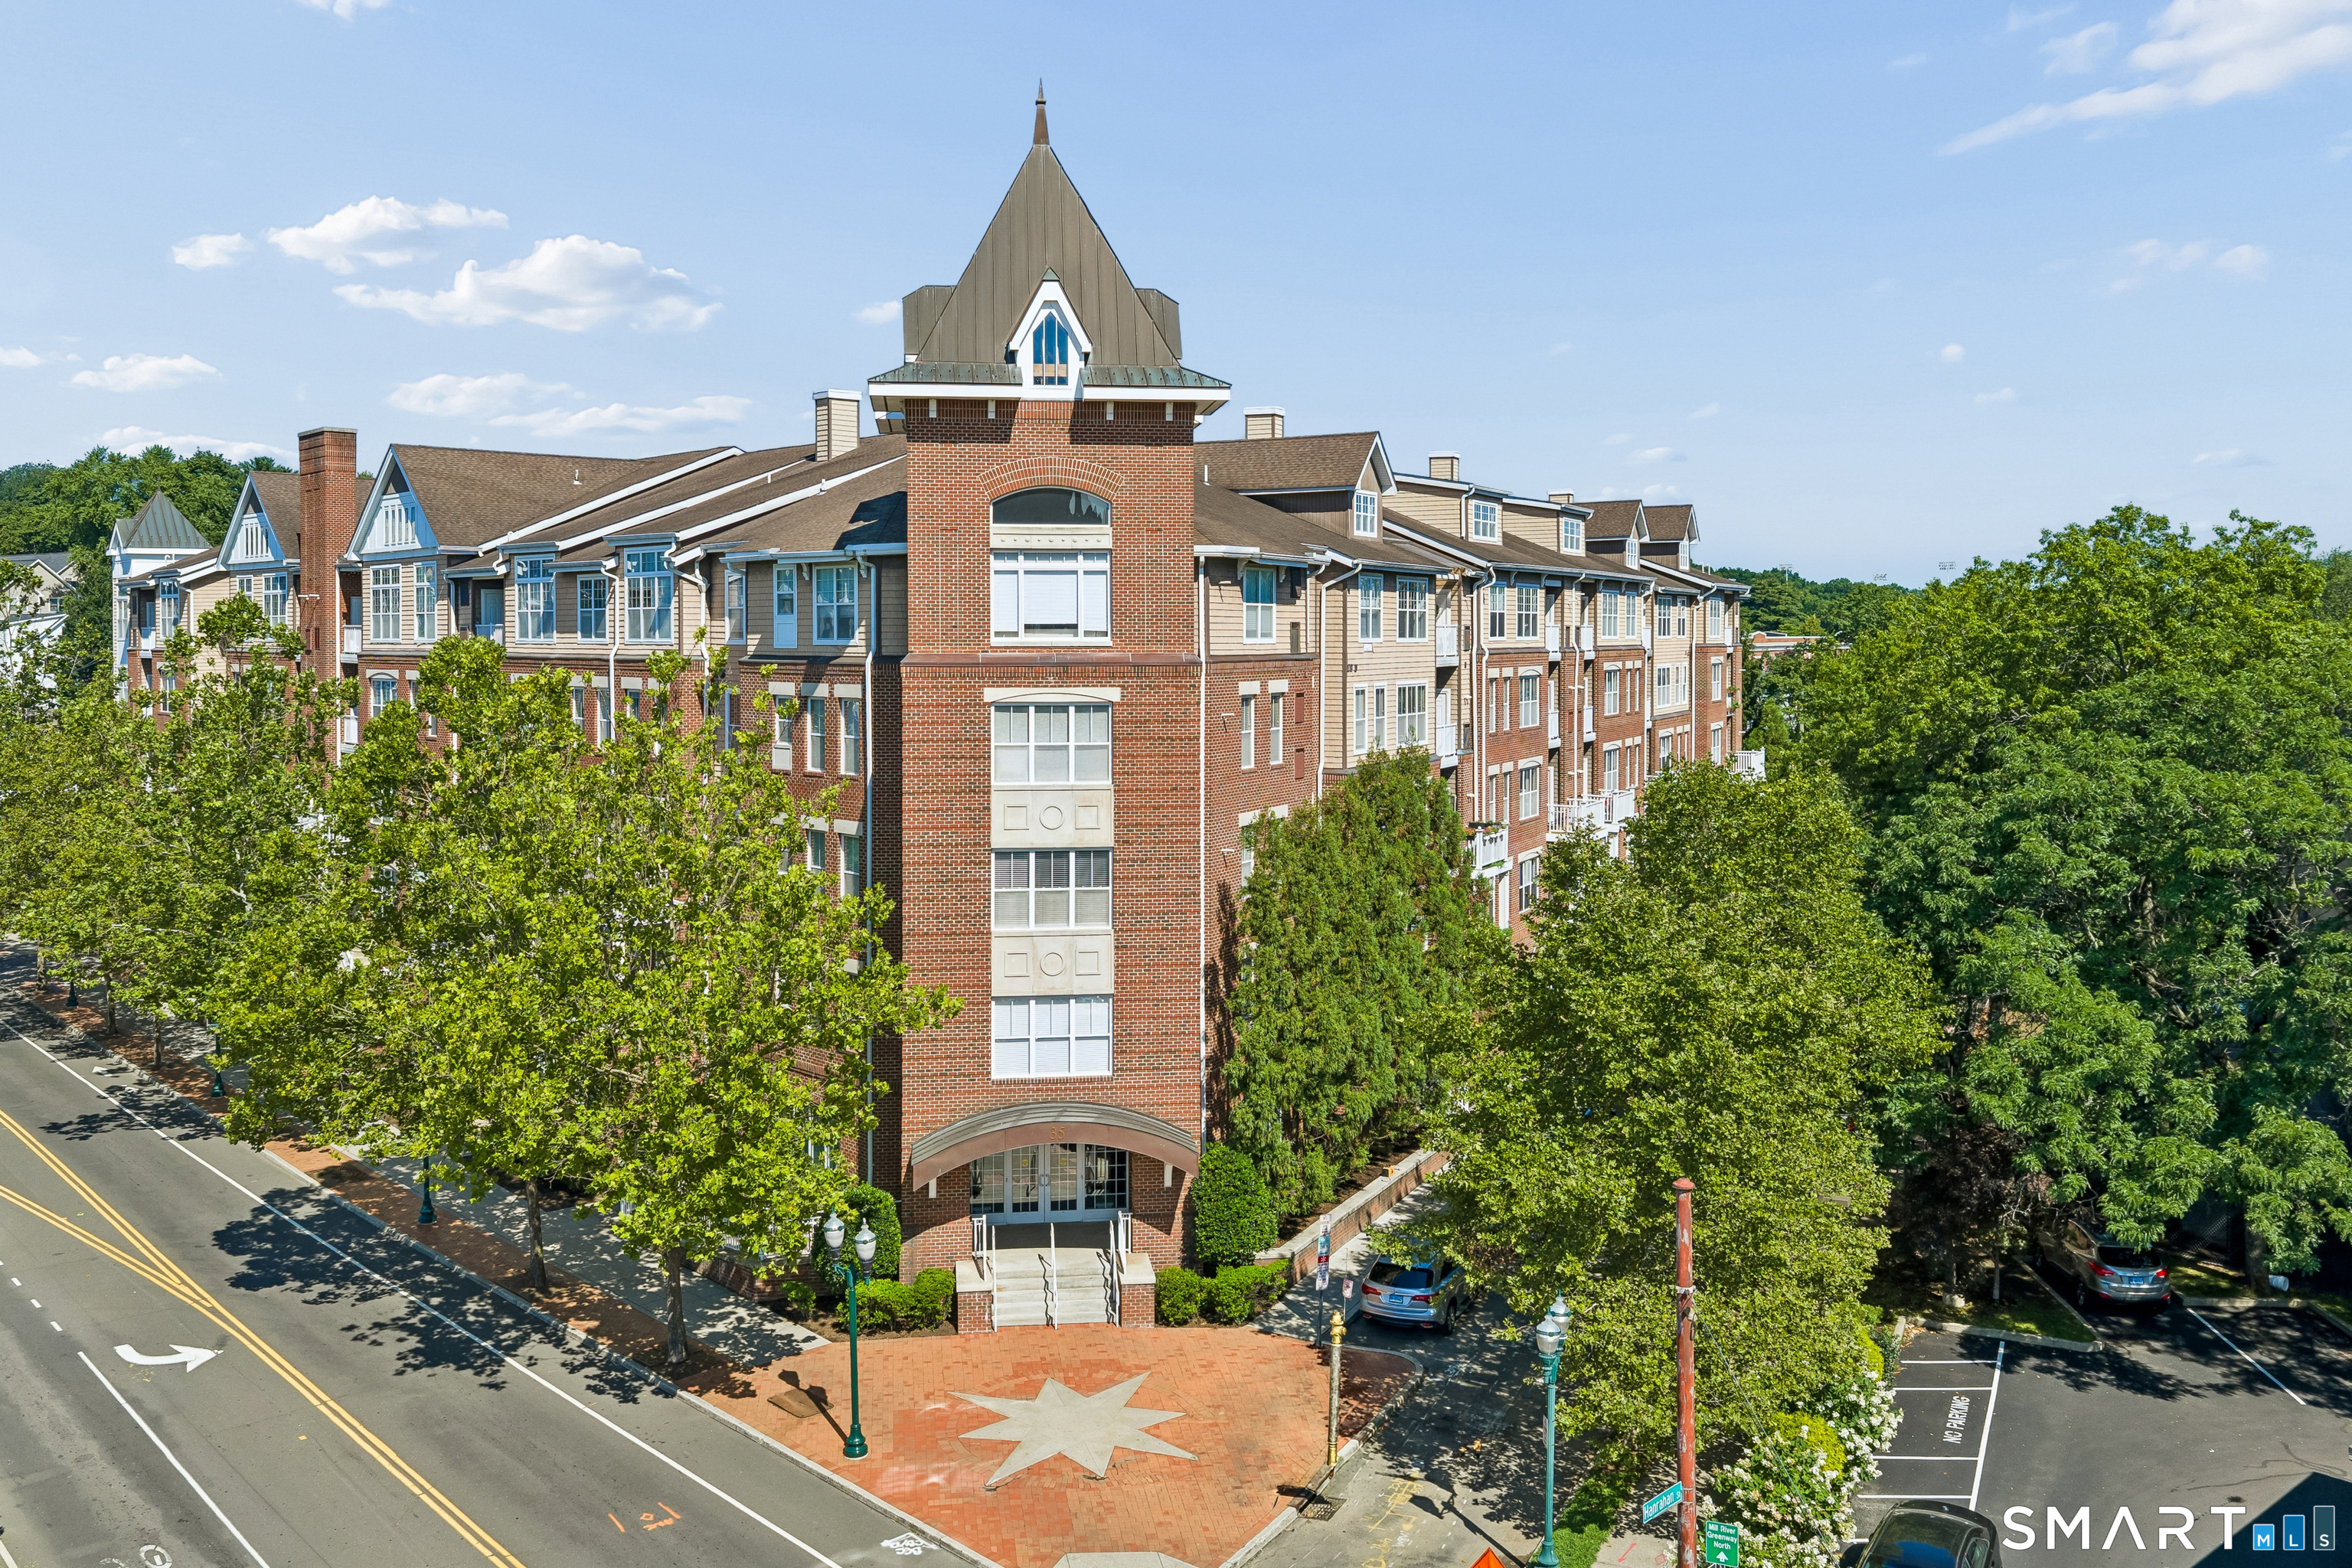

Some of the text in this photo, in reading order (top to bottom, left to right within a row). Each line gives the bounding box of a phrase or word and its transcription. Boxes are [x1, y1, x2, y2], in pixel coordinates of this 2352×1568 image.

[1049, 1126, 1065, 1140] 35
[1942, 1396, 1971, 1444] NO PARKING
[1644, 1491, 1674, 1521] Hanrahan
[1708, 1523, 1736, 1534] Mill River
[1707, 1530, 1738, 1544] Greenway
[1713, 1540, 1731, 1550] North
